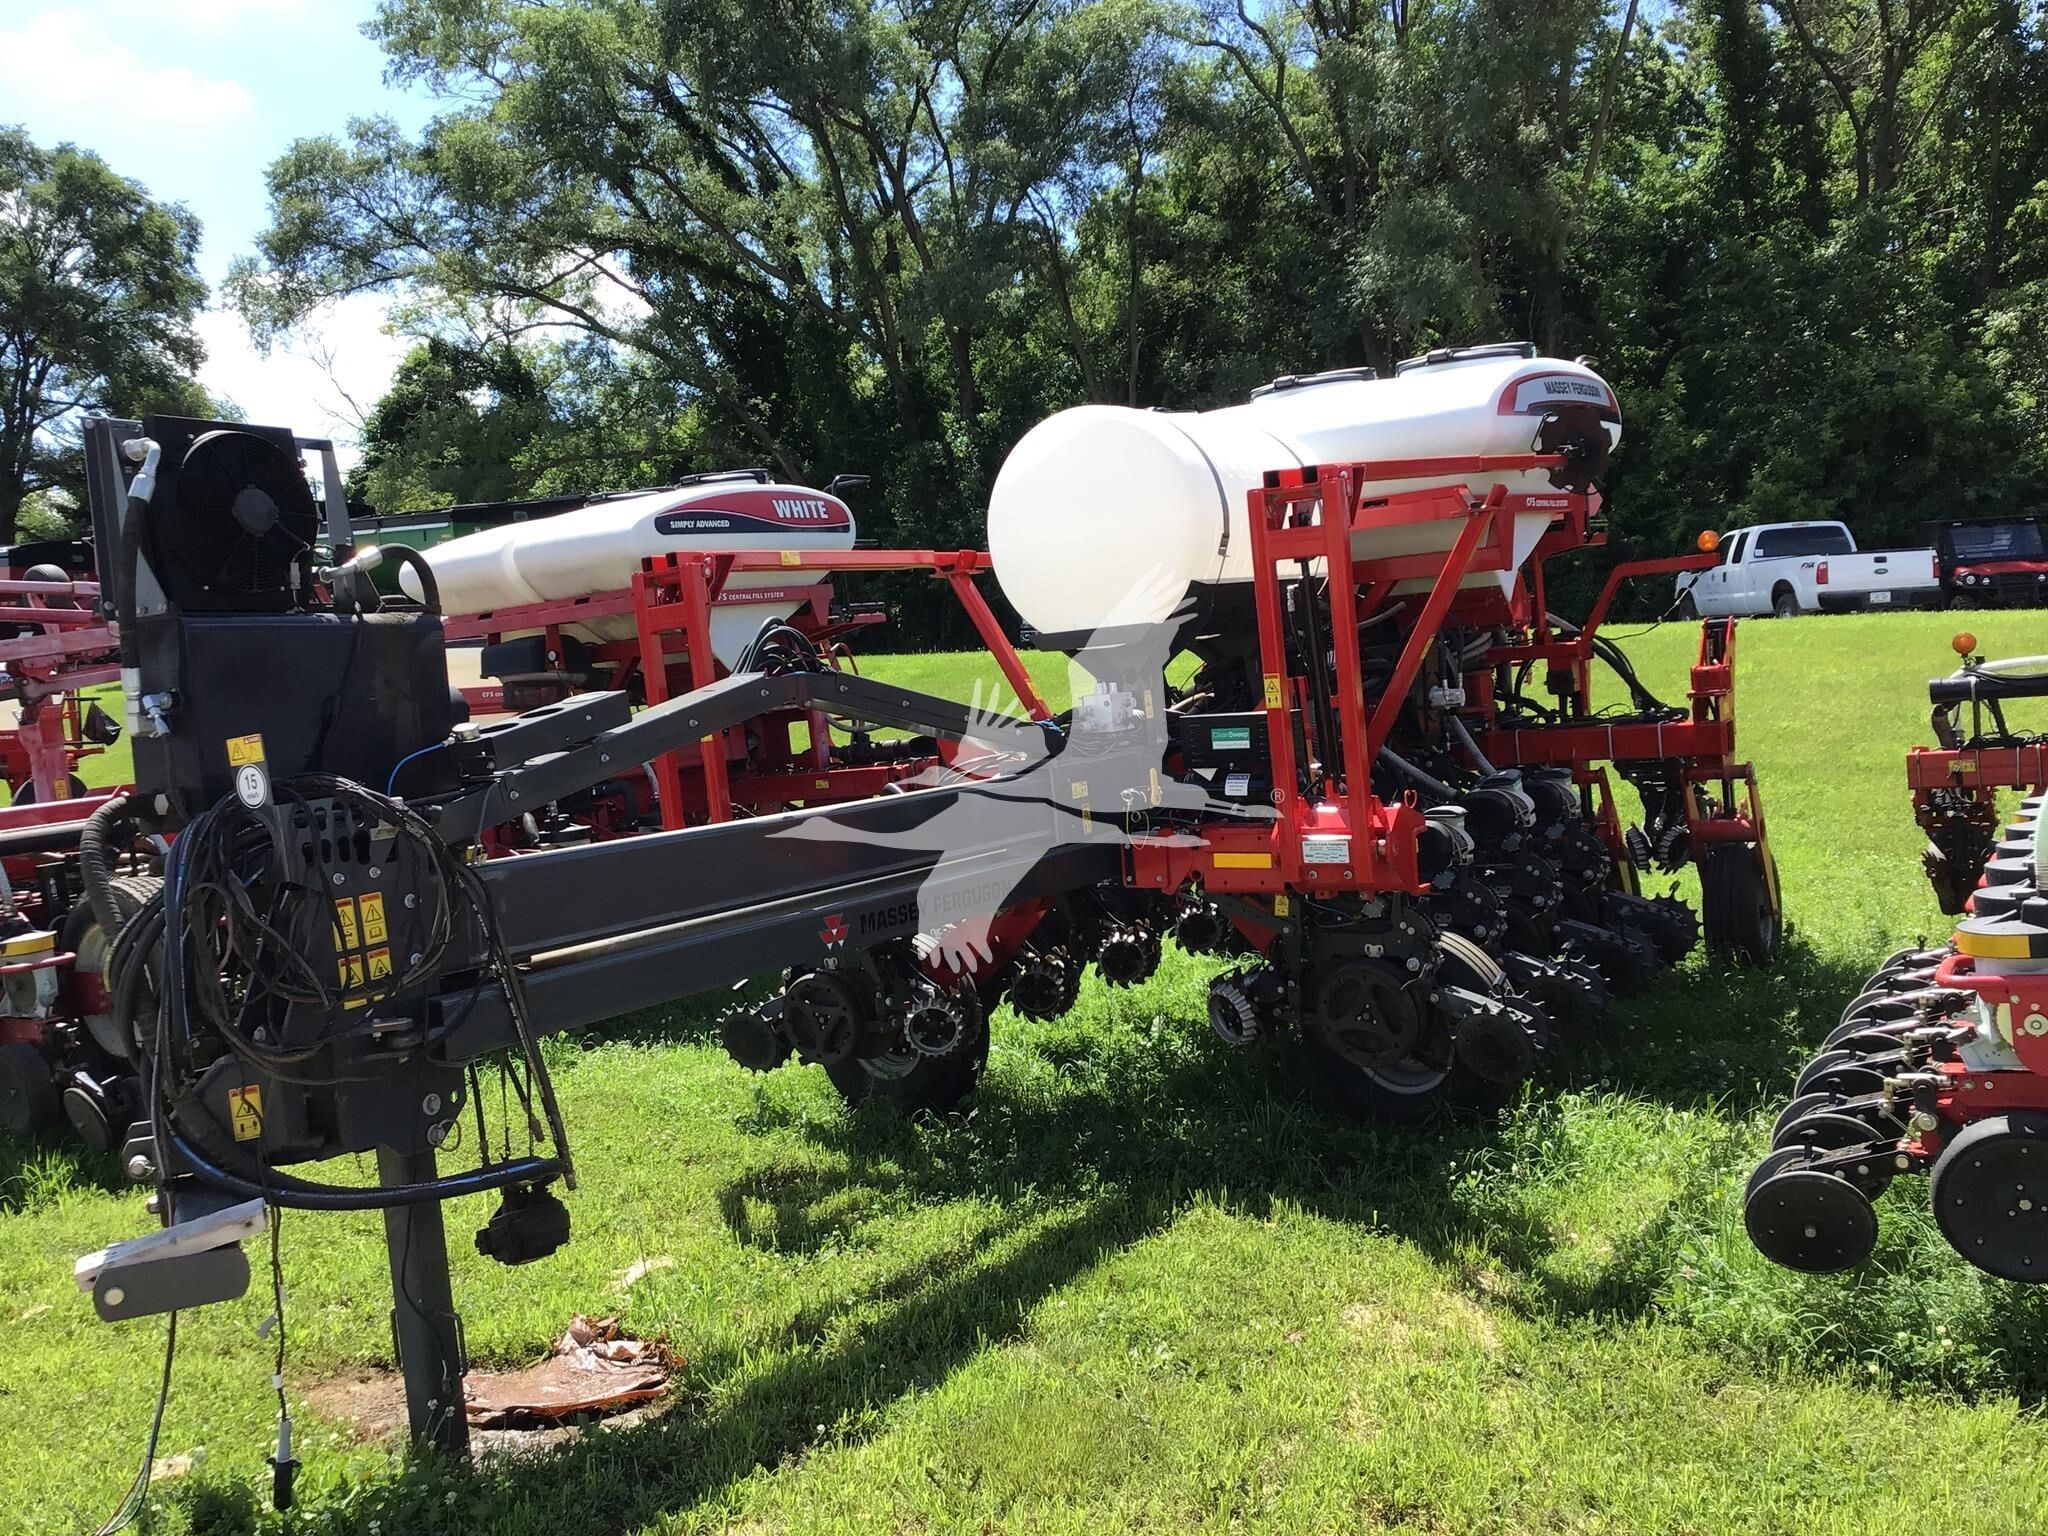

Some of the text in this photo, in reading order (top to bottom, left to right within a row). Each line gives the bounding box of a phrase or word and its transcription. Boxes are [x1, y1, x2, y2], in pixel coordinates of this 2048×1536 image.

[1544, 381, 1602, 399] MASSEY FERGUSON
[772, 499, 829, 519] WHITE
[670, 519, 730, 529] SIMPLY ADVANCED
[718, 592, 728, 601] FS
[729, 593, 752, 601] CENTRAL
[764, 591, 784, 599] SYSTEM
[481, 691, 494, 699] CFS
[244, 773, 259, 791] 15
[860, 878, 1013, 935] MASSEY FERGUSON
